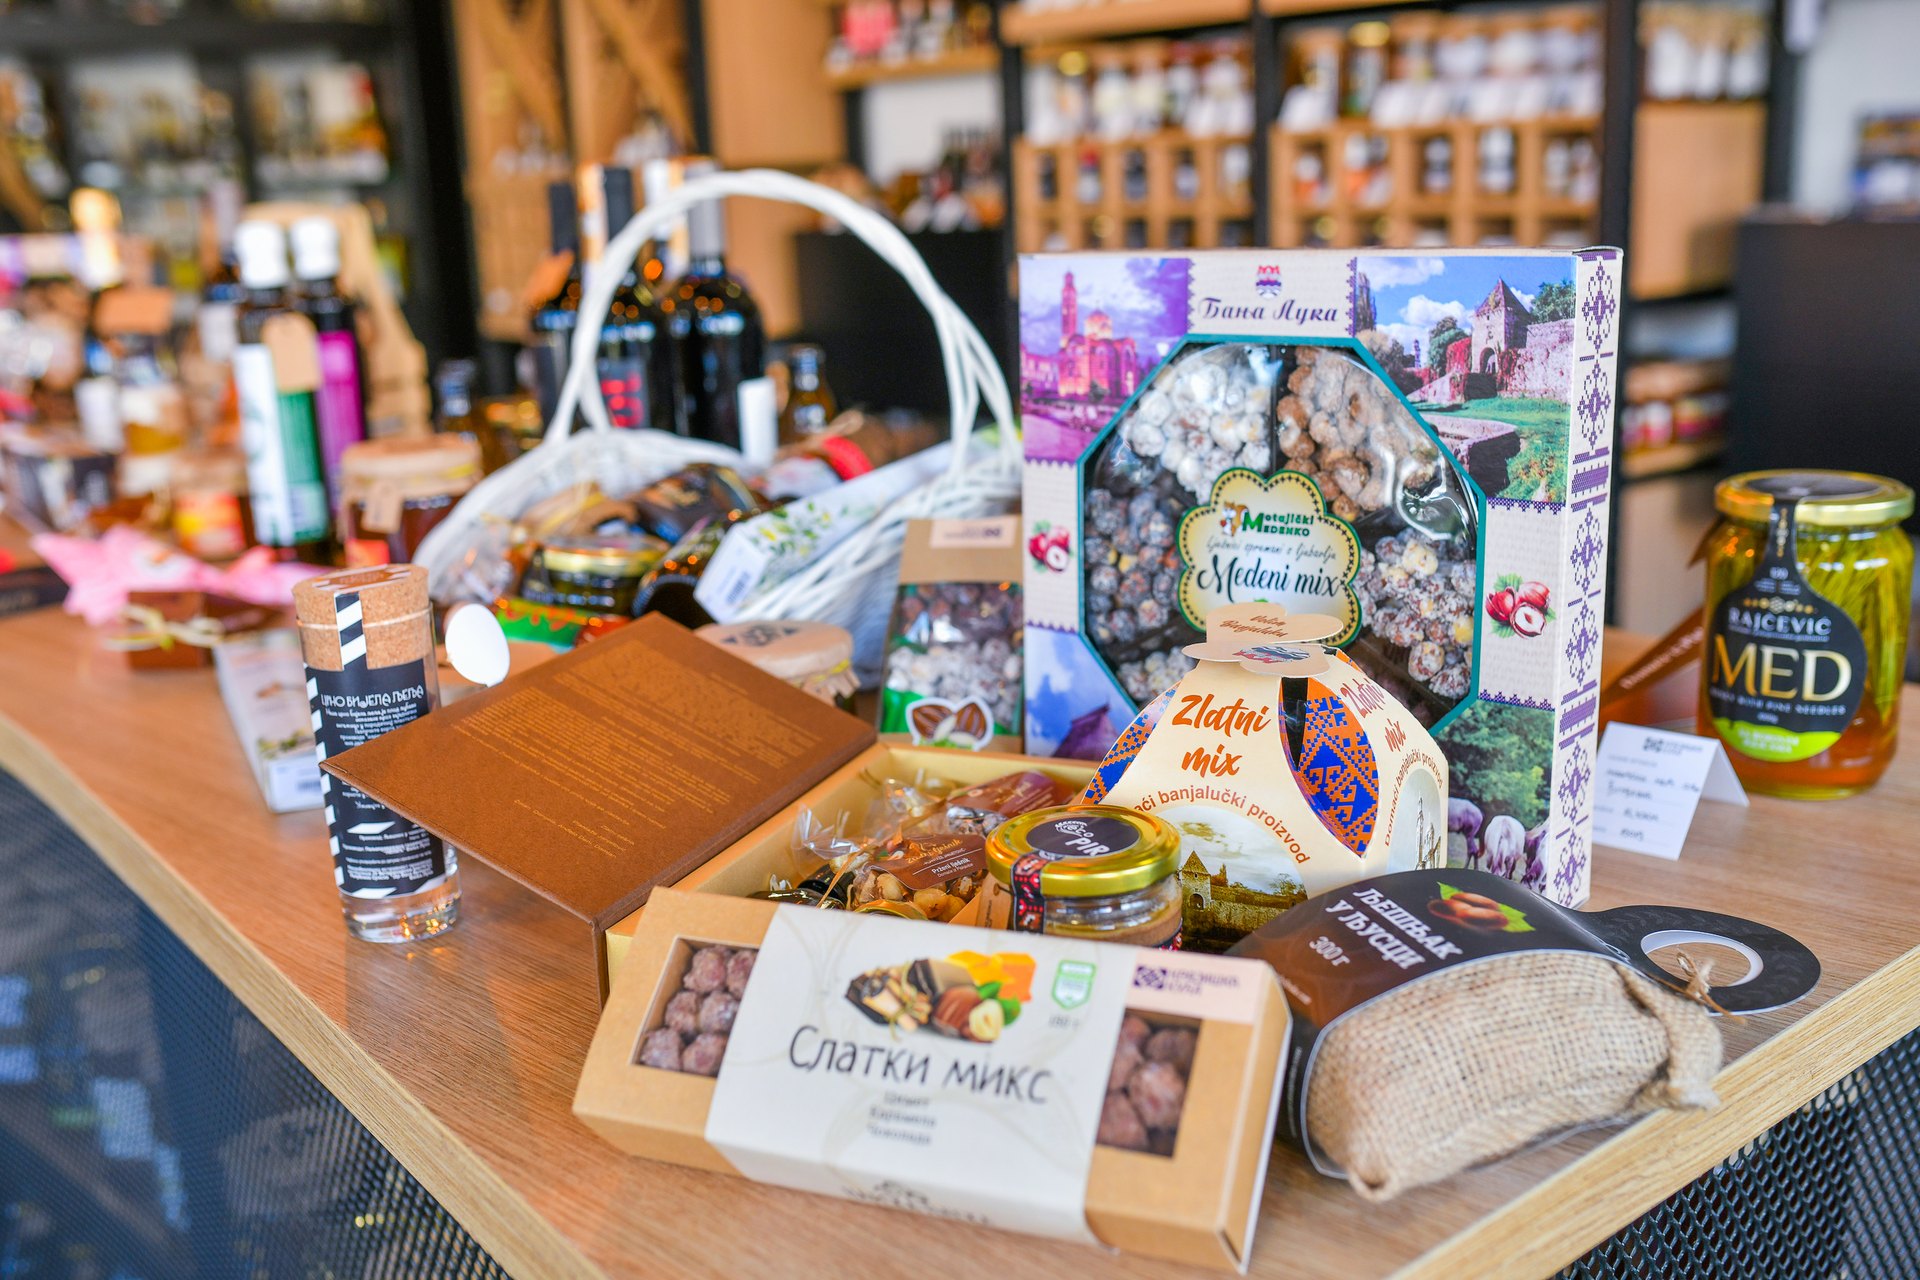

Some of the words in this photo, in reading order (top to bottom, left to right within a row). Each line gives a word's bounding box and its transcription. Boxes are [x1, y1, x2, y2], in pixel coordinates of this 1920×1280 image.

[1273, 299, 1338, 325] Лука
[1197, 553, 1290, 604] Medeni
[1294, 567, 1340, 597] mix
[1712, 634, 1852, 702] MED
[1171, 693, 1272, 738] Zlatni
[1339, 677, 1386, 719] Zlatni
[1384, 718, 1407, 753] mix
[1181, 743, 1243, 778] mix
[1421, 751, 1443, 789] proizvod
[1134, 795, 1157, 812] aći
[1158, 784, 1248, 810] banjalučki
[1246, 803, 1311, 864] proizvod
[1325, 900, 1354, 913] У
[1352, 888, 1464, 960] ЉЕШЊАК
[1309, 936, 1344, 961] 300
[1338, 911, 1427, 970] ЉУСЦИ
[789, 1024, 932, 1087] Слатки
[942, 1058, 1053, 1105] микс
